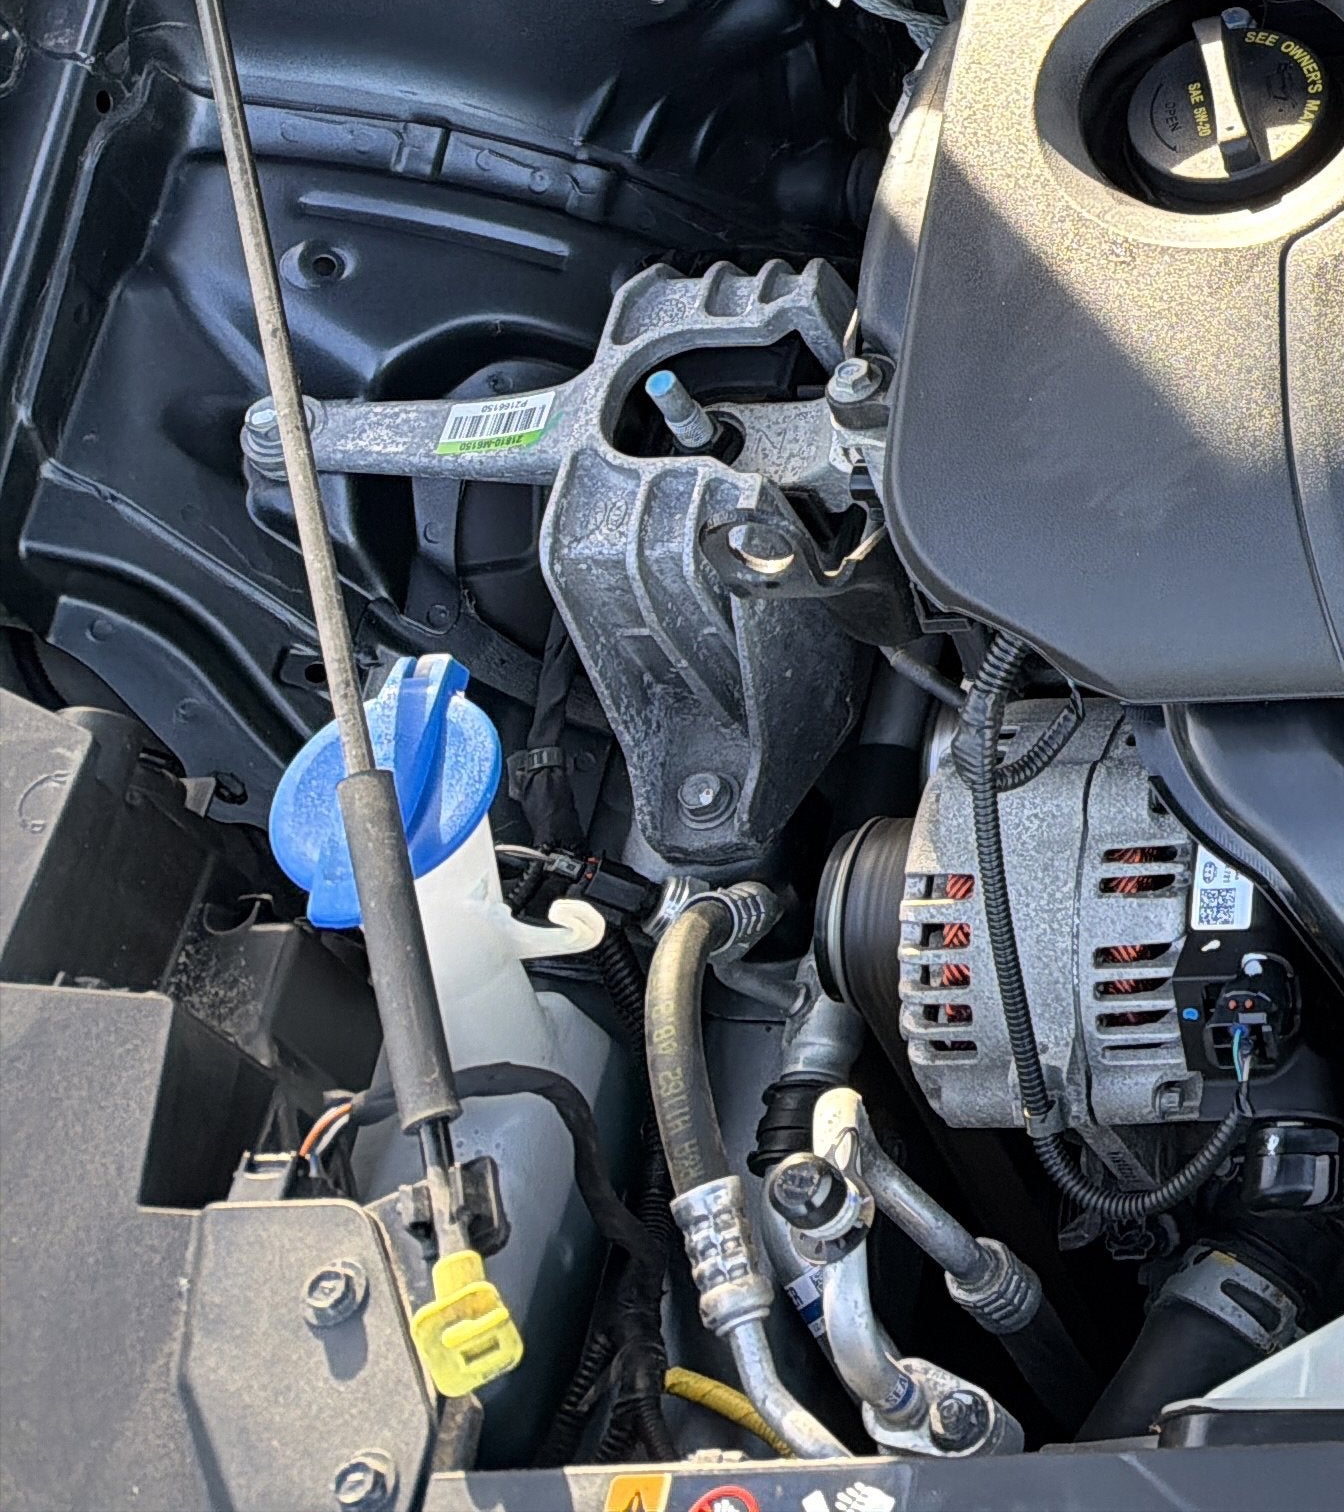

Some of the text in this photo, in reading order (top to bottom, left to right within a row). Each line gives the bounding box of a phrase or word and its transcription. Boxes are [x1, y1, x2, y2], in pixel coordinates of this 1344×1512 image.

[1244, 31, 1280, 47] SEE
[1280, 40, 1323, 94] OWNER'S
[1165, 102, 1182, 133] OPEN
[1188, 82, 1212, 137] SAE 5W-20
